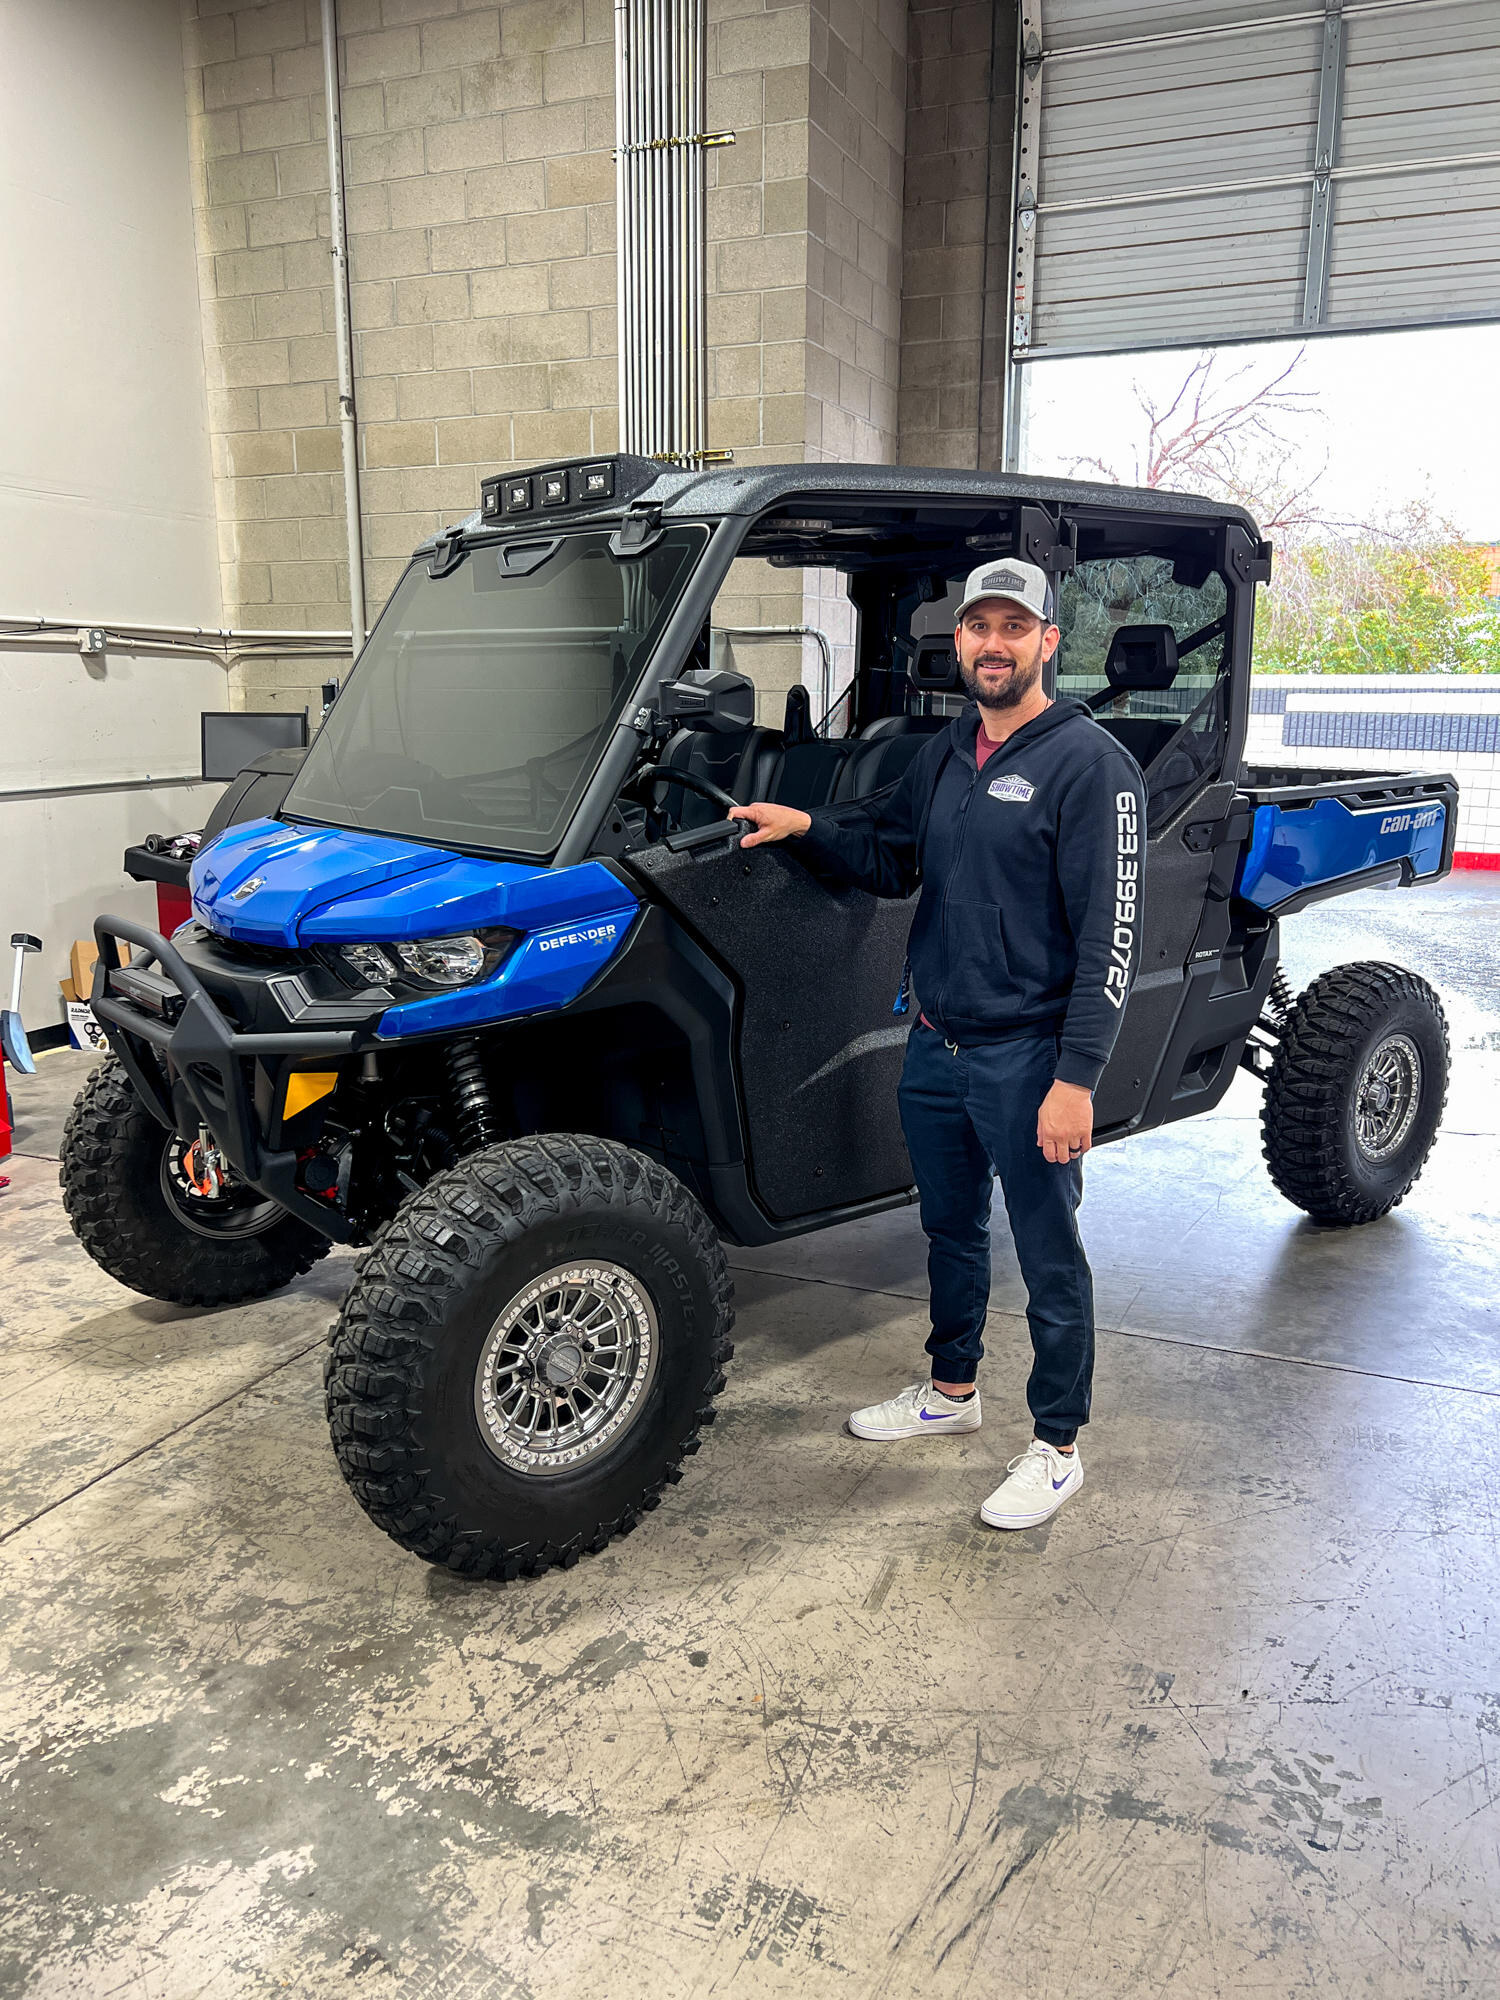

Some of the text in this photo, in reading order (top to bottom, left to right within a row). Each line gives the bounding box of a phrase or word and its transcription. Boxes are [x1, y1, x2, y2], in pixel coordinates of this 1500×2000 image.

[990, 782, 1032, 799] SHOWTIME
[1380, 811, 1438, 835] can-am
[1104, 791, 1138, 1009] 623.399.0727
[539, 924, 617, 952] DEFENDER
[593, 934, 617, 946] XT
[1195, 950, 1213, 959] ROTAX
